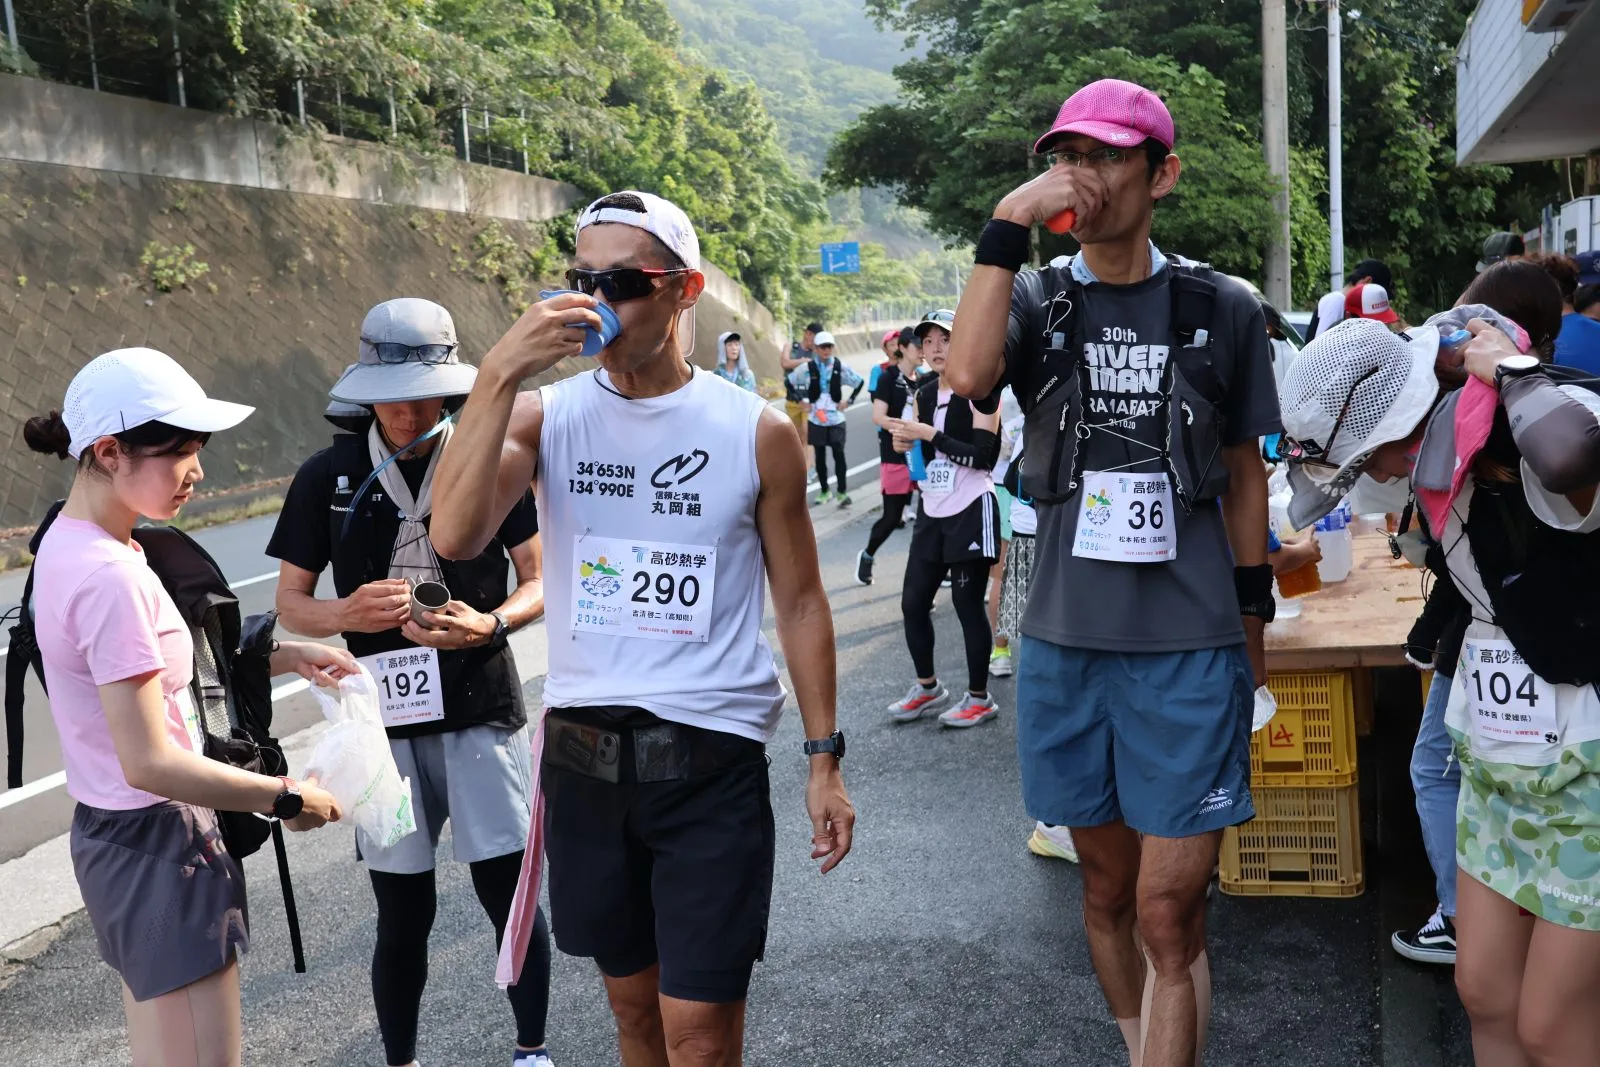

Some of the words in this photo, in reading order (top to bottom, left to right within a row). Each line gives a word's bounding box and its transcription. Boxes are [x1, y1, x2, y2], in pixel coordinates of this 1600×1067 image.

[1102, 327, 1137, 343] 30th
[1083, 342, 1170, 370] RIVER
[931, 470, 950, 484] 289
[655, 490, 700, 502] 信頼と実績
[651, 500, 702, 517] 丸岡組
[1128, 500, 1163, 530] 36
[651, 550, 707, 568] 高砂熱学
[631, 570, 700, 607] 290
[388, 652, 430, 669] 高砂熱学
[381, 670, 430, 699] 192
[1472, 670, 1539, 707] 104
